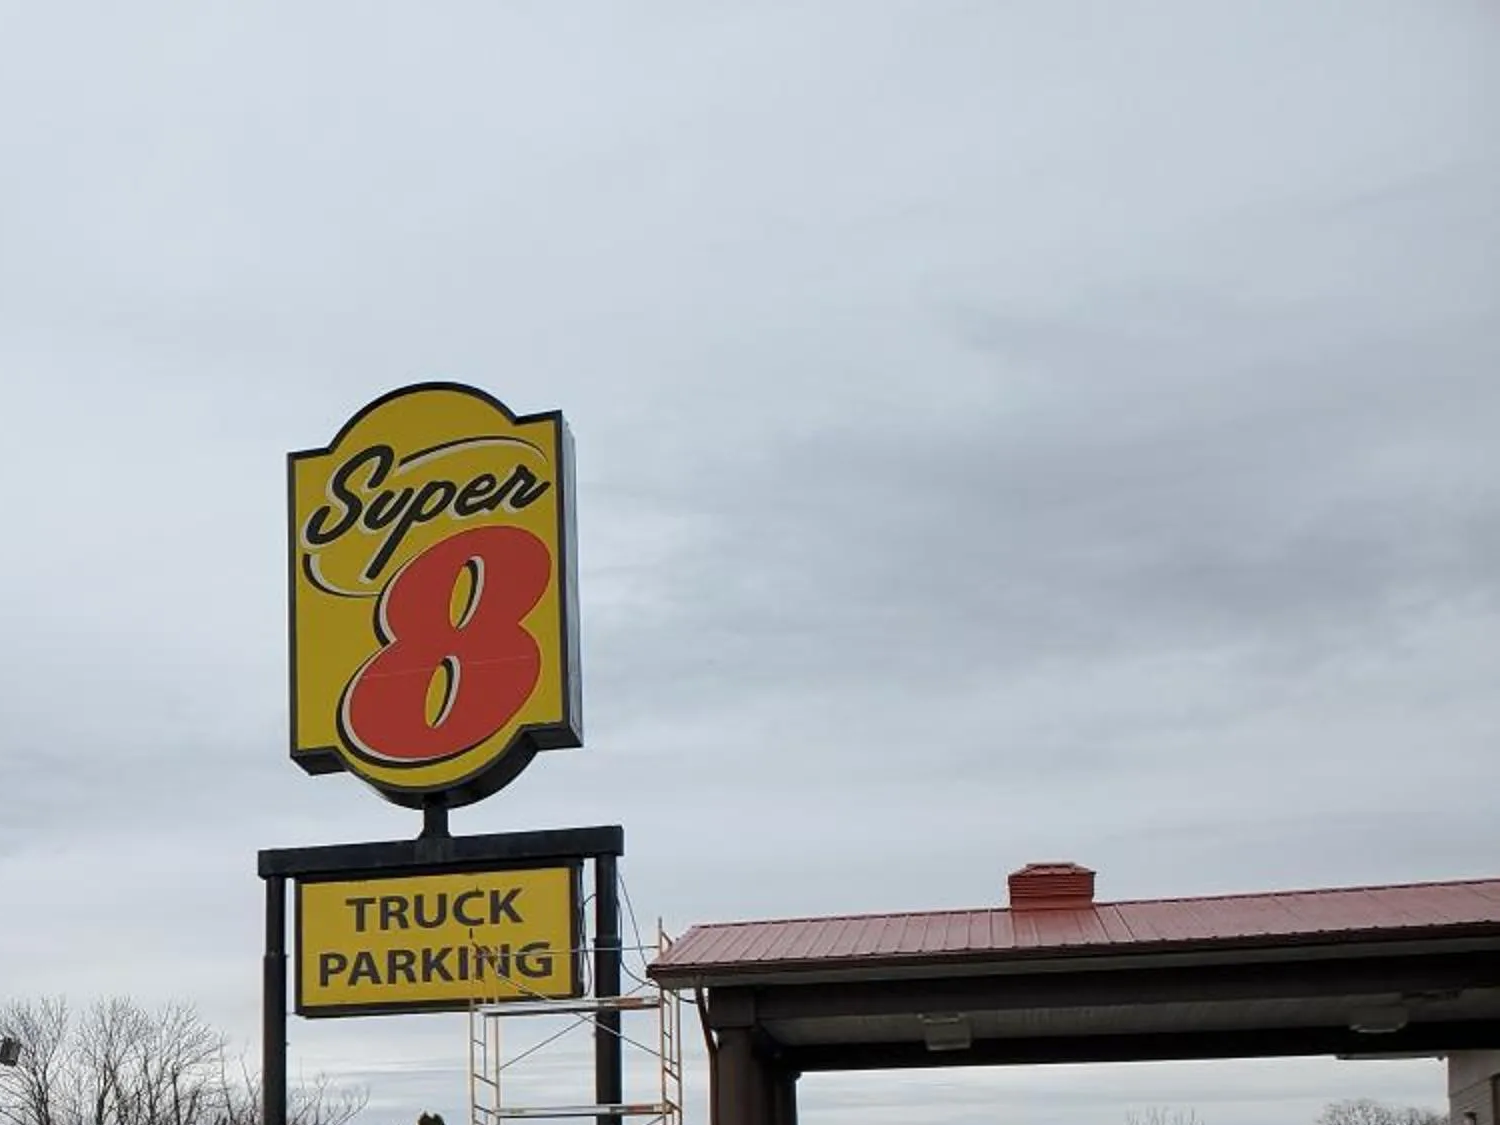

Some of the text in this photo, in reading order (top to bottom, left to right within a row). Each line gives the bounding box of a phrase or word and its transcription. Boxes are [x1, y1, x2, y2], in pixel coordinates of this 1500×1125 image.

[305, 444, 551, 582] Super
[336, 524, 552, 769] 8
[345, 887, 524, 933] TRUCK
[319, 941, 553, 988] PARKING
